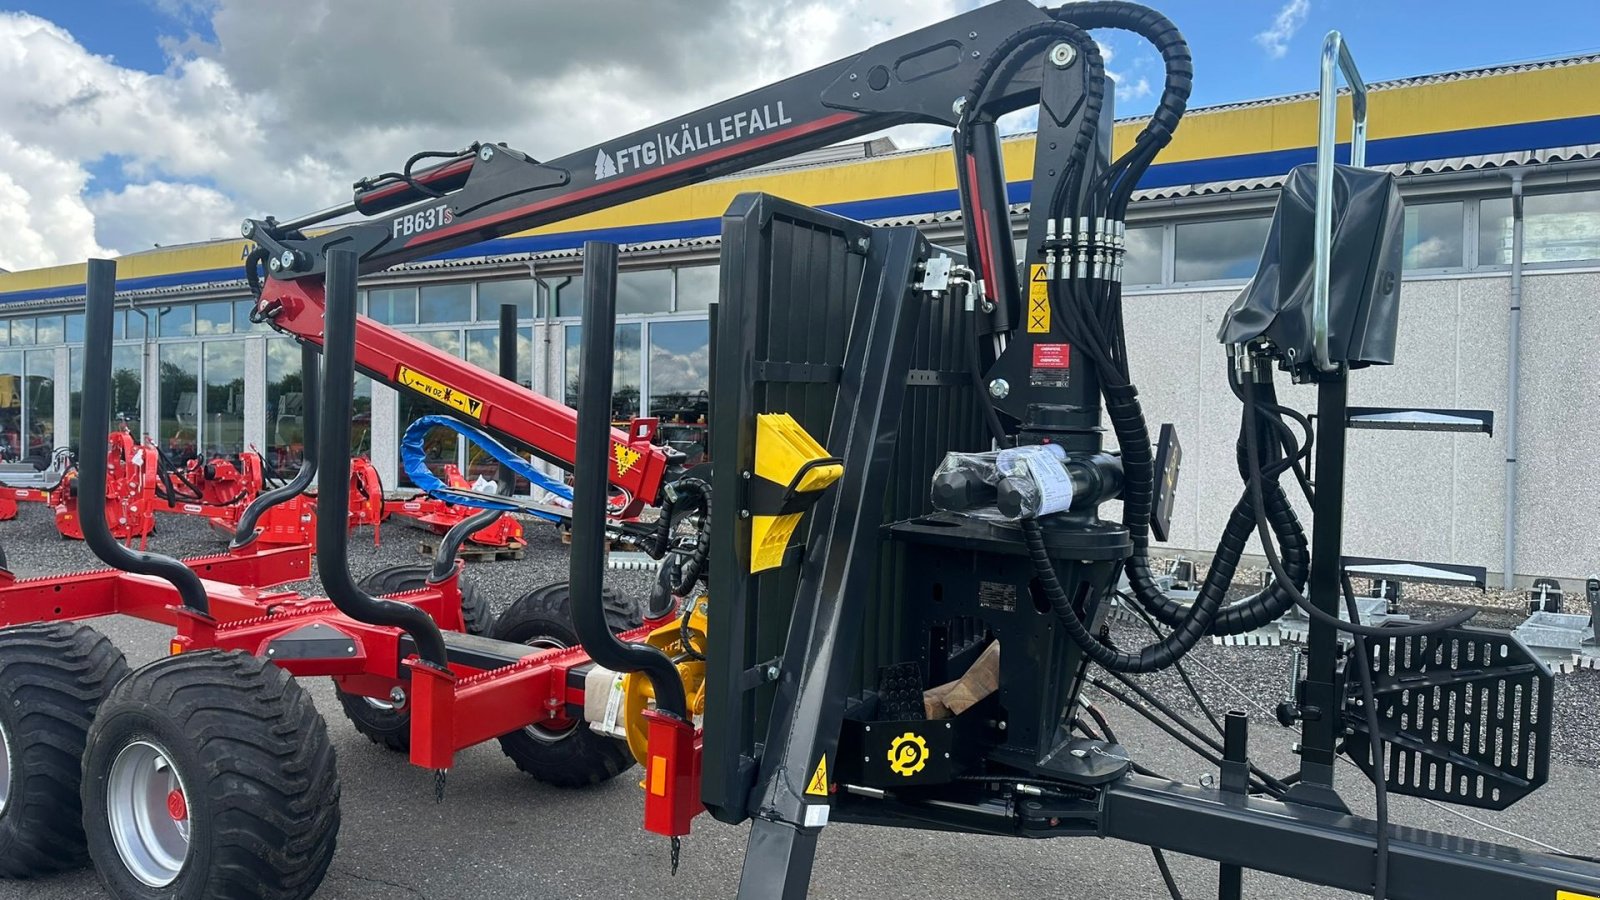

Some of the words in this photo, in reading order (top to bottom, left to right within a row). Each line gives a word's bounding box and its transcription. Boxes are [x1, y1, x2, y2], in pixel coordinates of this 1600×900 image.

[616, 141, 657, 174] FTG
[664, 100, 792, 159] KÄLLEFALL
[425, 384, 432, 393] M
[433, 388, 442, 397] 20
